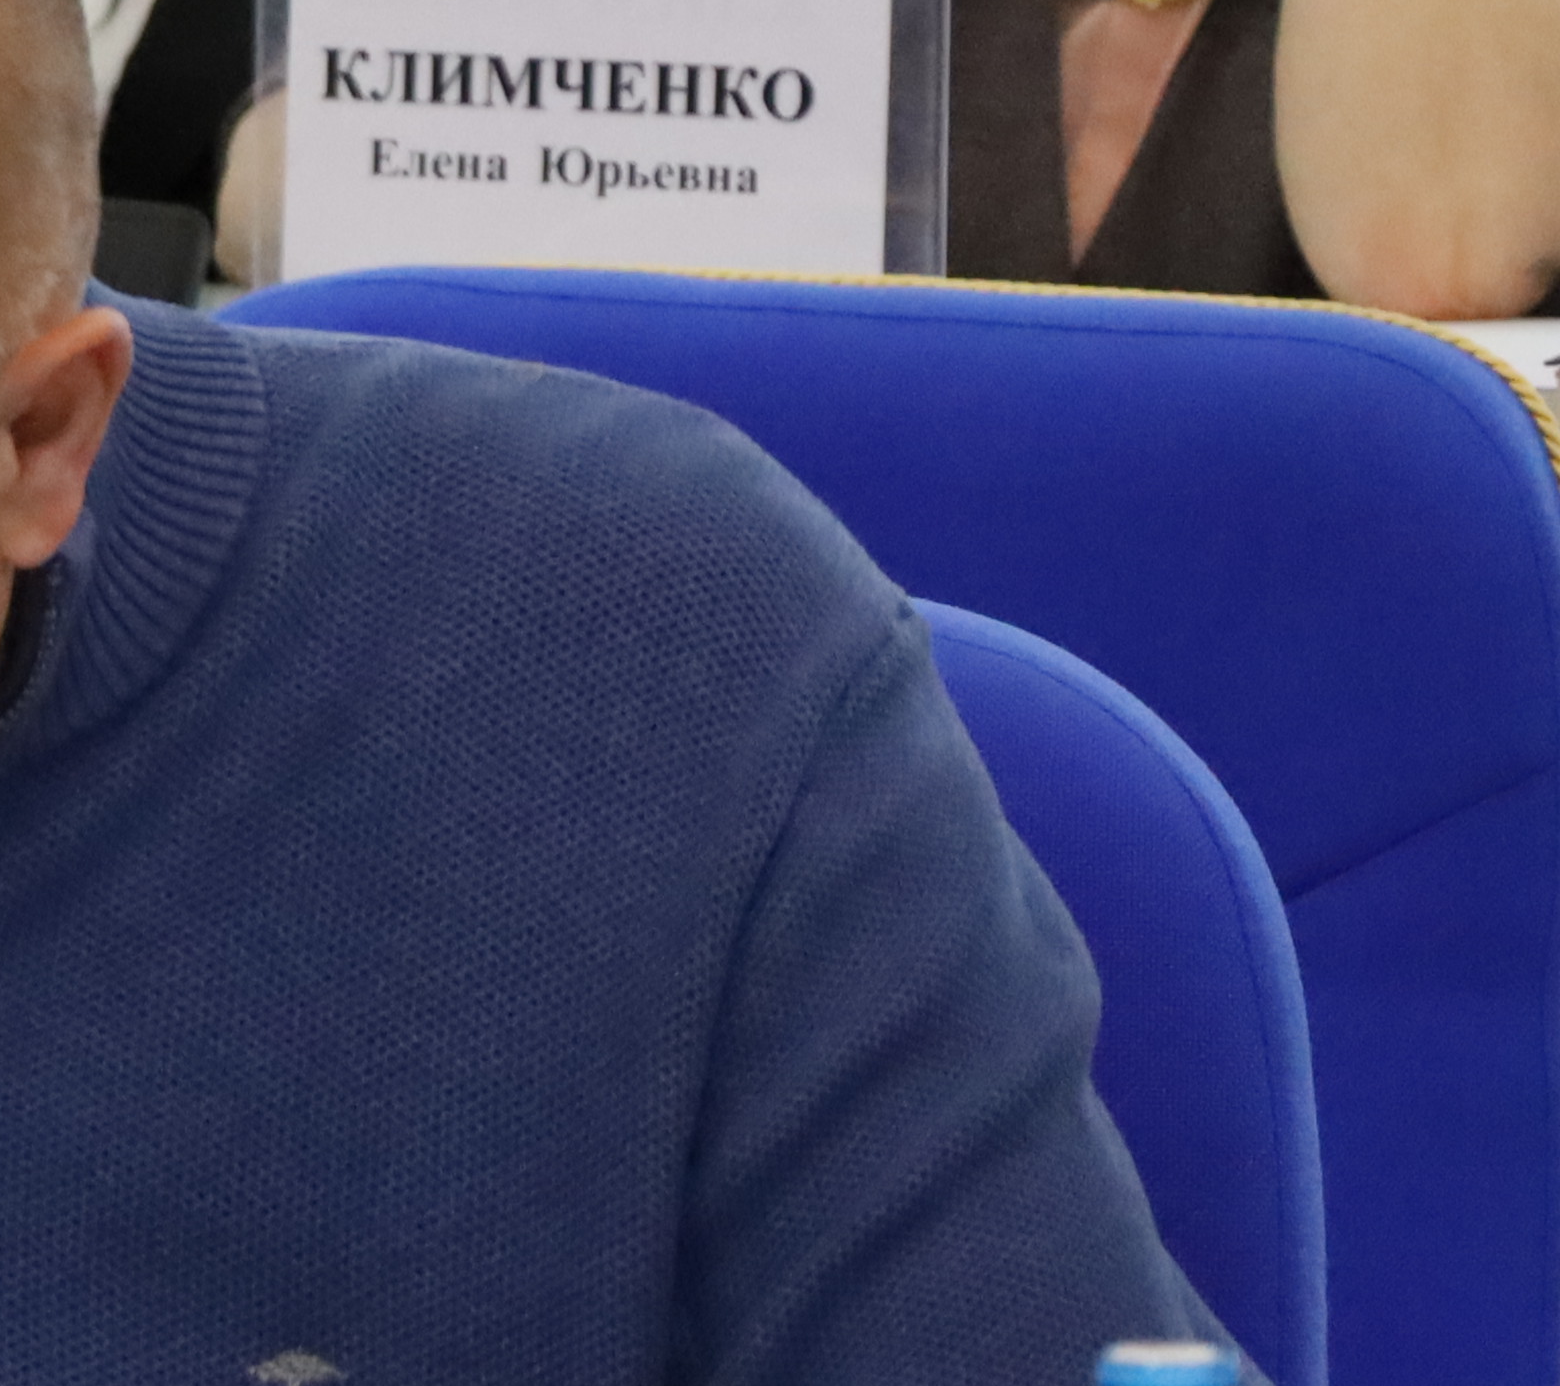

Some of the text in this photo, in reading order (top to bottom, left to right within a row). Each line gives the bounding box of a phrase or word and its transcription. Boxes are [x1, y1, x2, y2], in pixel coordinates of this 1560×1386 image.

[323, 47, 815, 123] КЛИМЧЕНКО
[371, 138, 758, 199] Елена Юрьевна
